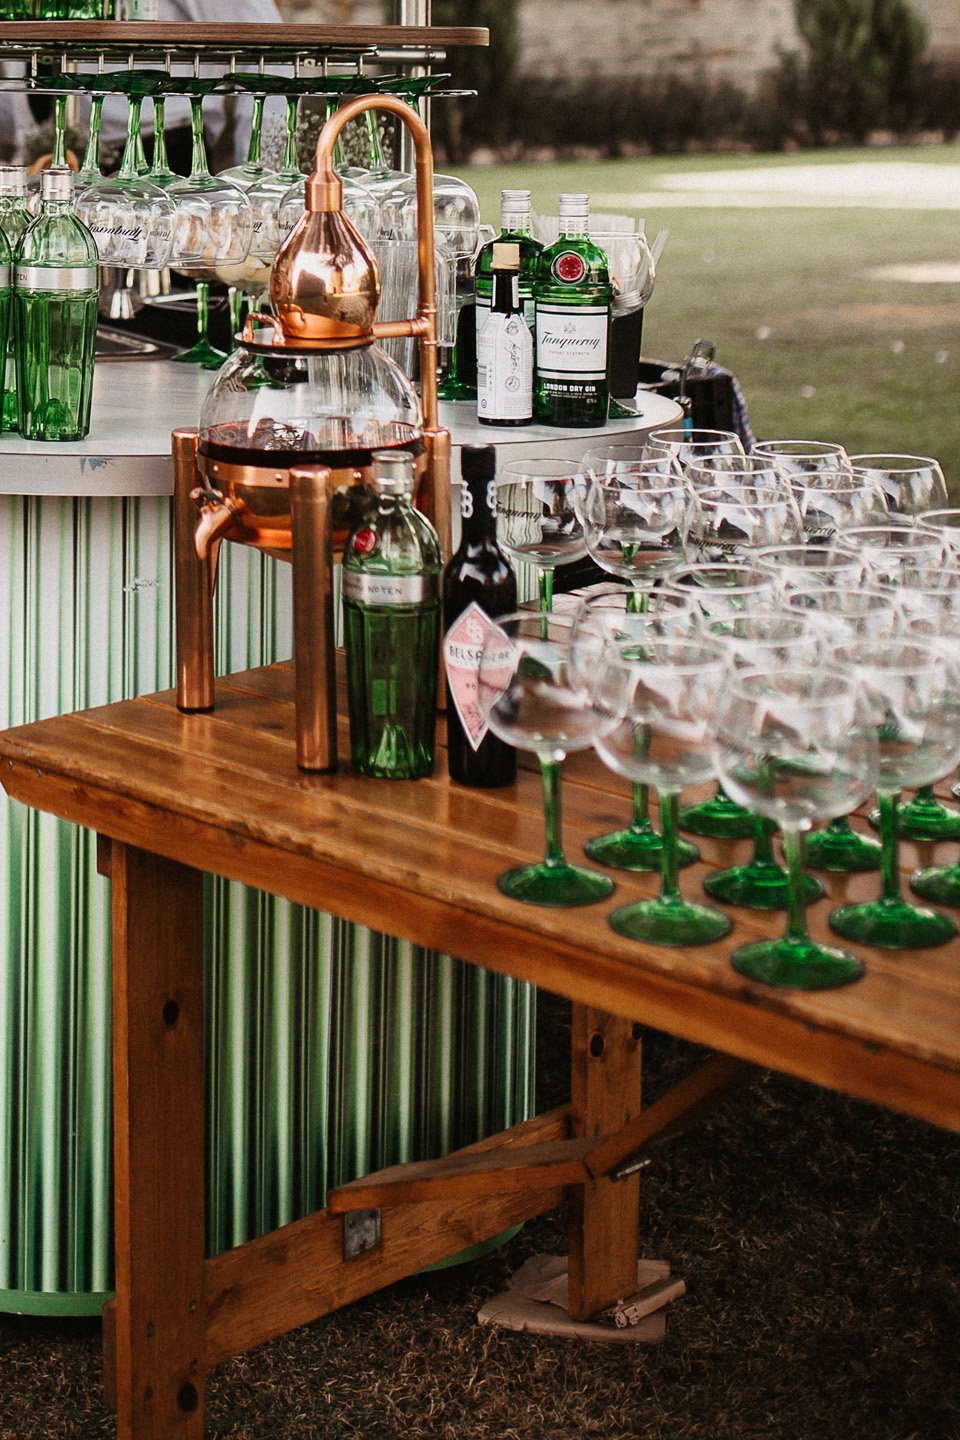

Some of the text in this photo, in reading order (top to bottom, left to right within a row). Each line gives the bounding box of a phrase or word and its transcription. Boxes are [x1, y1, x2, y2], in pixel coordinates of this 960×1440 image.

[541, 331, 601, 350] Tanqueray
[543, 382, 596, 393] LONDON DRY GIN
